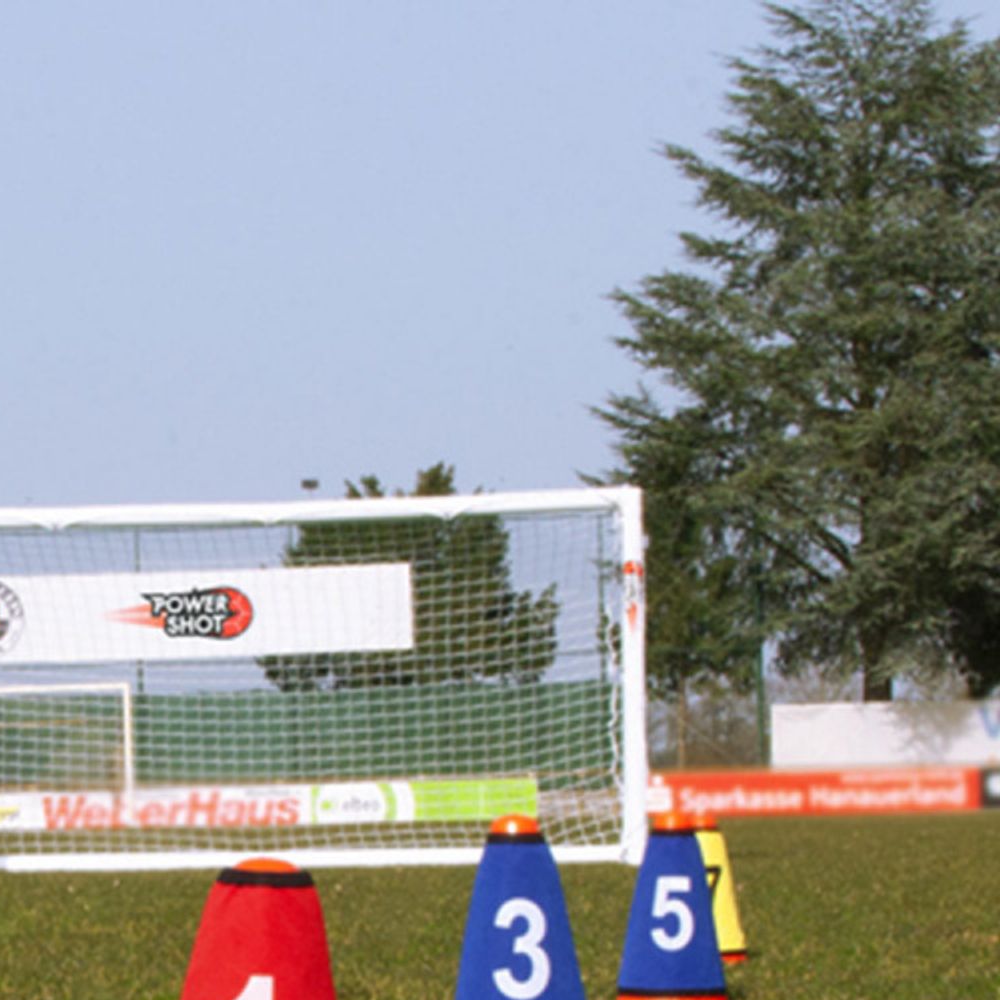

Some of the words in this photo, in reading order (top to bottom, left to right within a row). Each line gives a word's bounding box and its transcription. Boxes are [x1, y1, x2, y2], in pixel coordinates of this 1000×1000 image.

[151, 595, 229, 612] POWER
[167, 614, 225, 634] SHOT
[650, 876, 694, 951] 5
[492, 897, 551, 1000] 3
